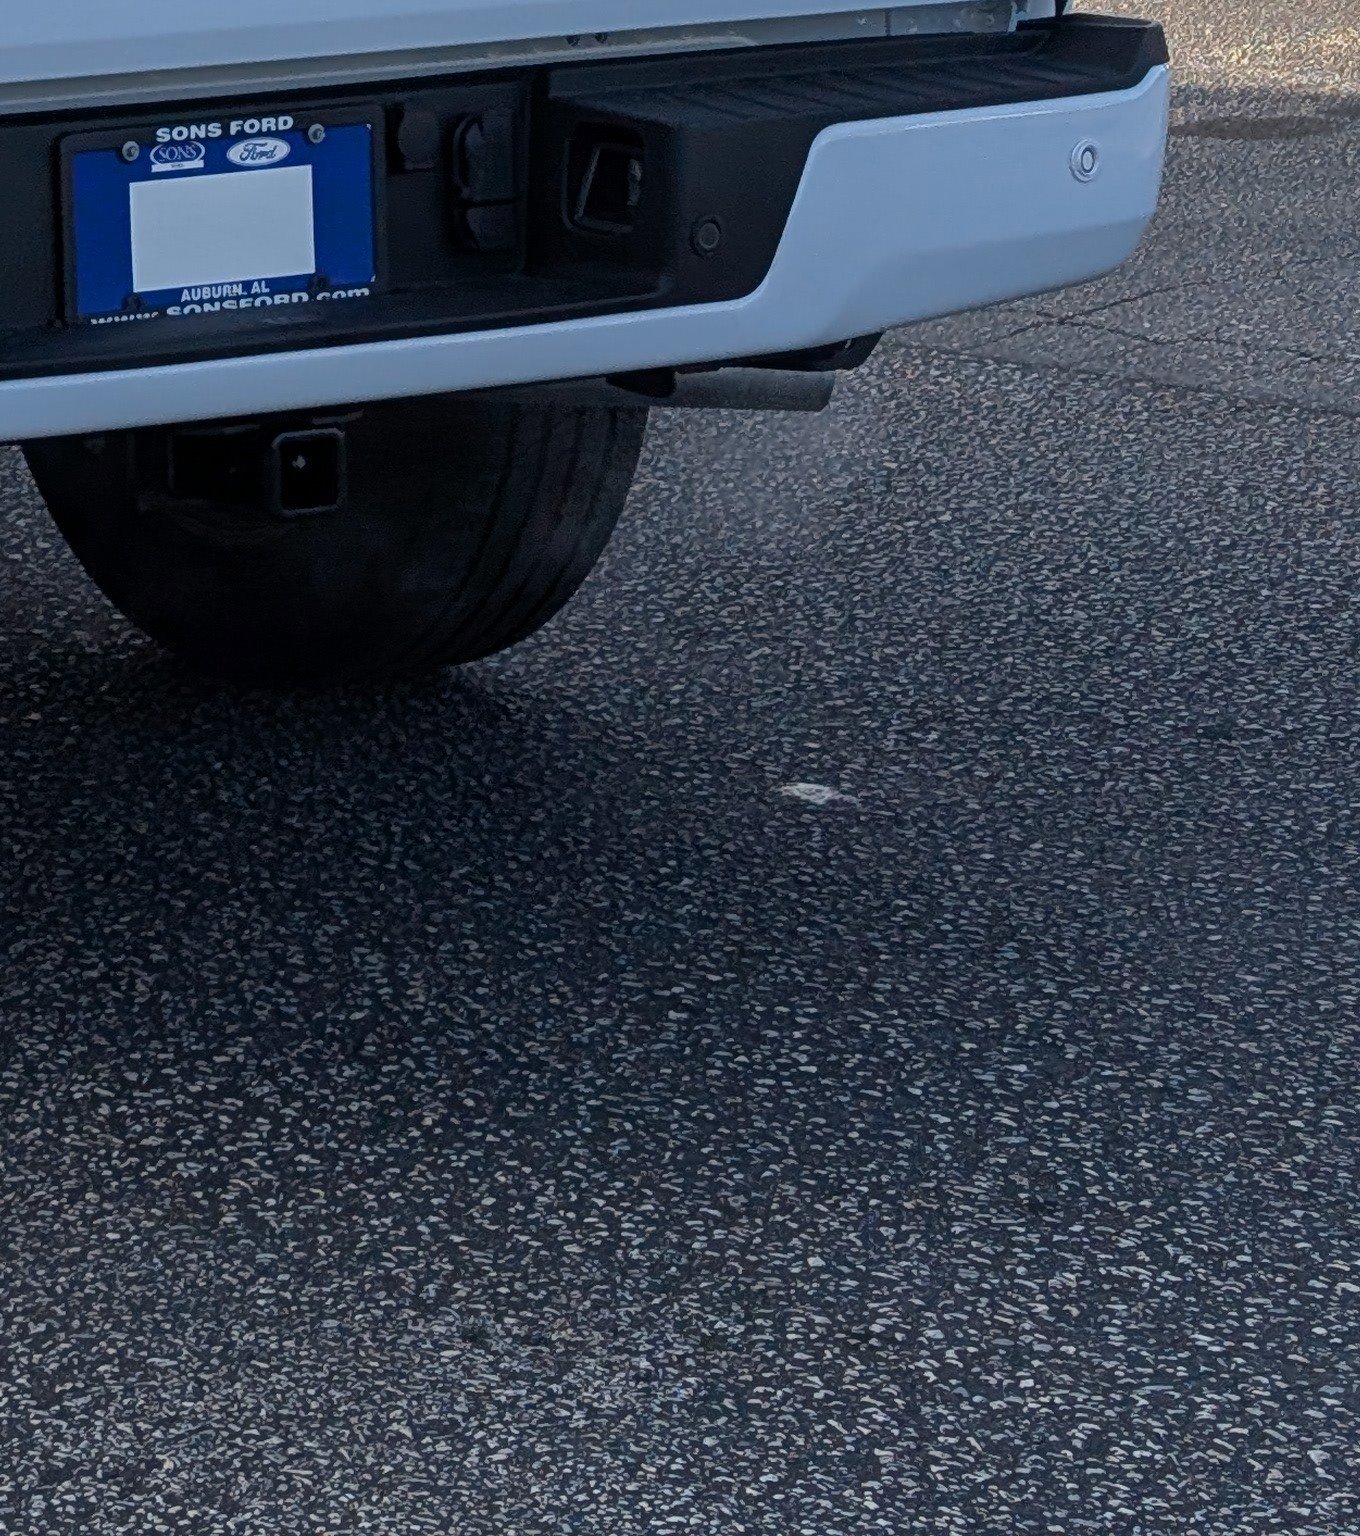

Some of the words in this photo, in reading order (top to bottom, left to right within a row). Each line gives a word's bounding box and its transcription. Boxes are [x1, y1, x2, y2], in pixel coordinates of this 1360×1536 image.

[155, 122, 222, 143] SONS
[229, 115, 294, 136] FORD
[239, 142, 278, 162] Ford
[251, 280, 270, 294] AL
